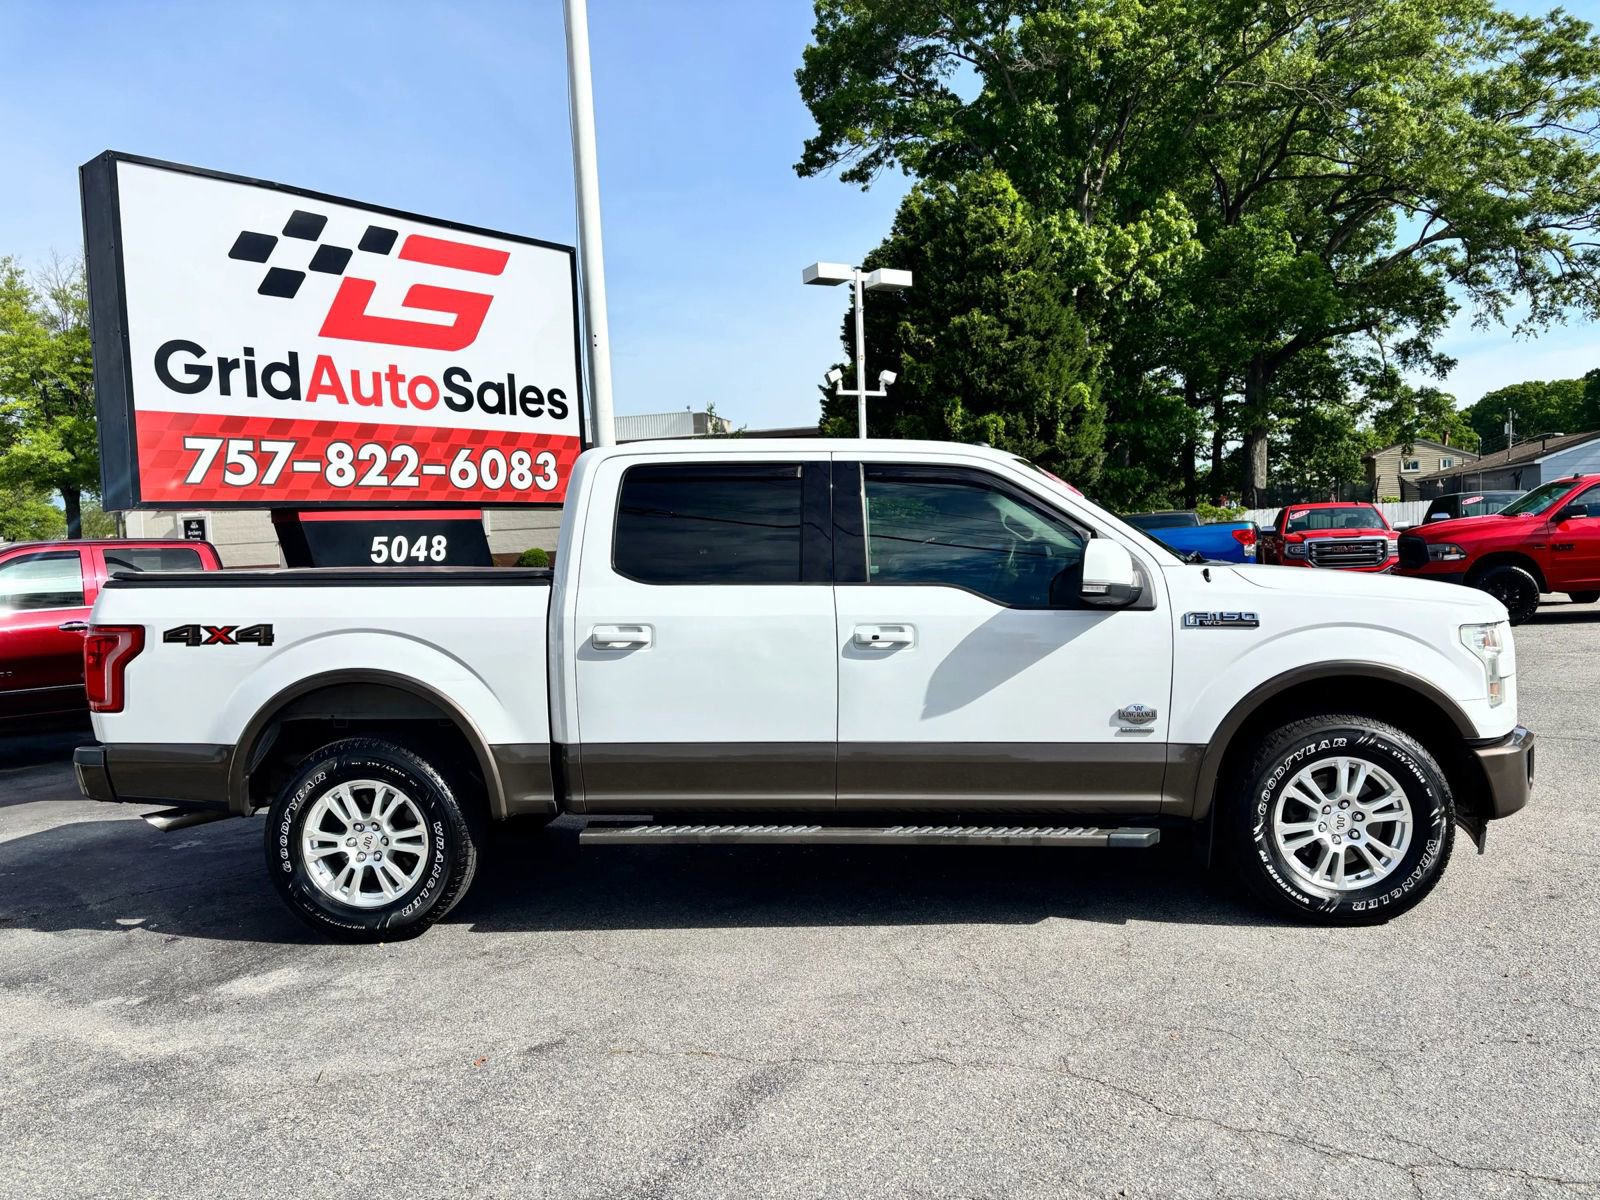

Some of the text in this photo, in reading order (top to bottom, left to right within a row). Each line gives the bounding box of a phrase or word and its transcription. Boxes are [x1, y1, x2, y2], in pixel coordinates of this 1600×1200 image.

[182, 435, 559, 491] 757-822-6083
[370, 535, 448, 563] 5048
[1257, 737, 1348, 816] GOODYEAR
[279, 771, 327, 873] GOODYEAR
[401, 821, 445, 917] WRANGLER
[1351, 839, 1438, 911] WRANGLER
